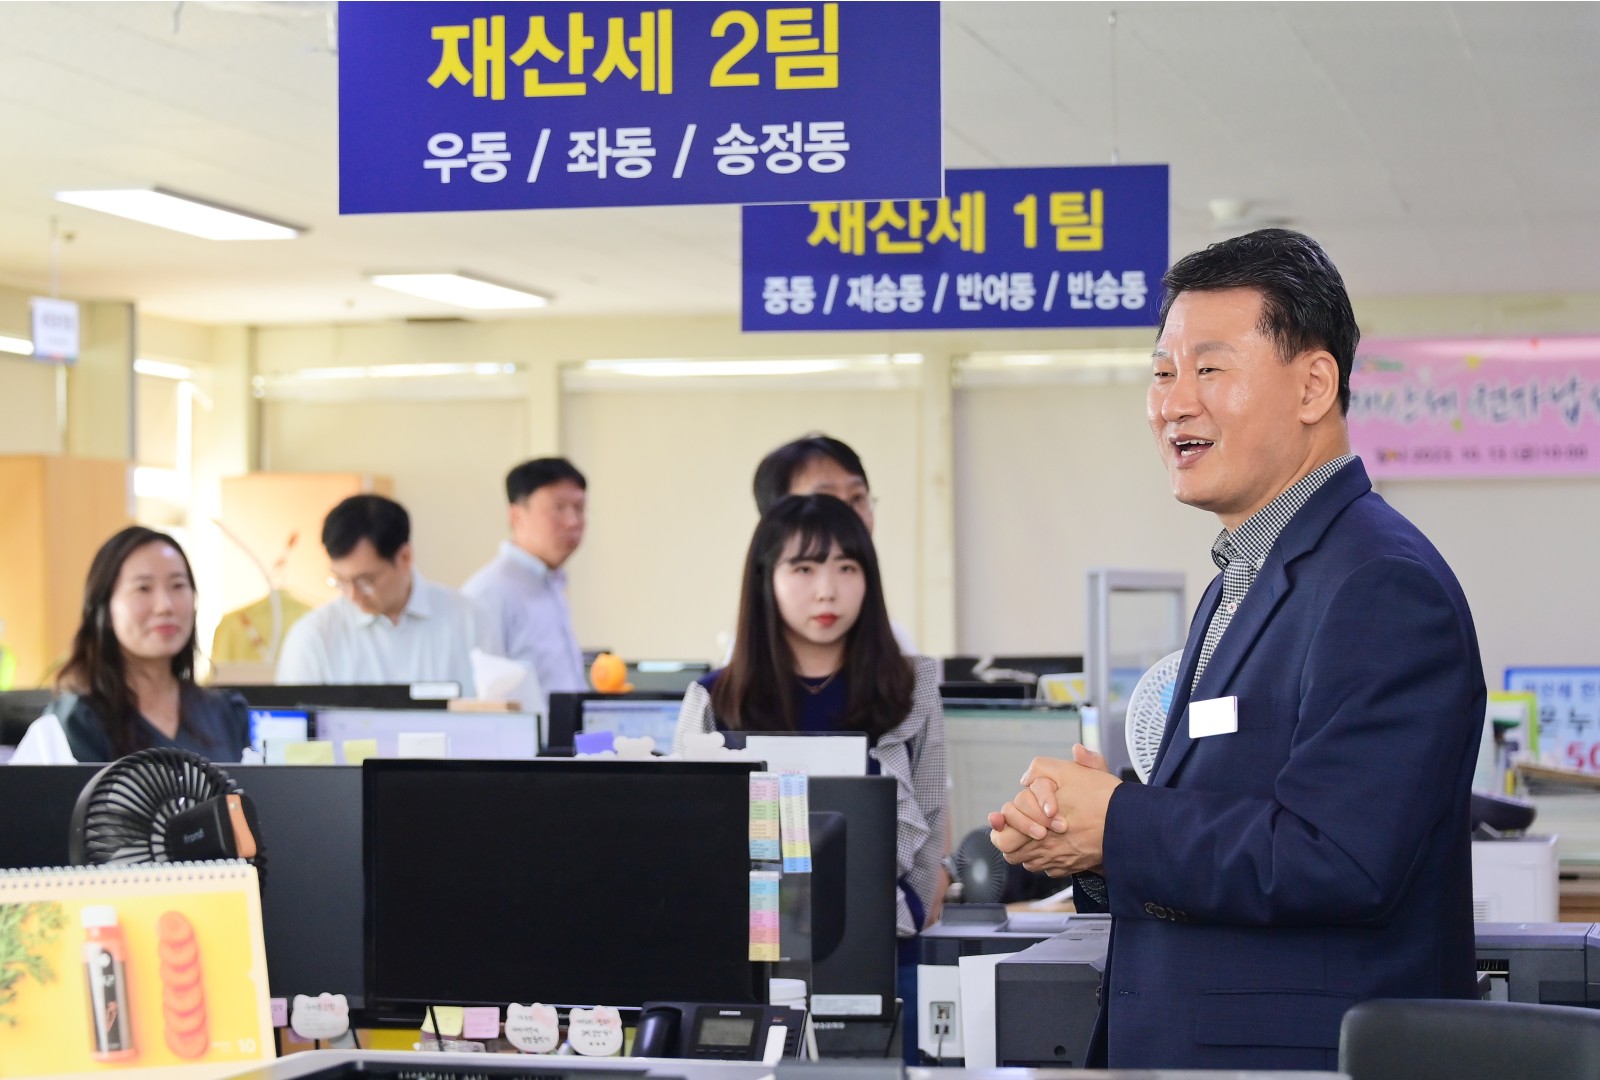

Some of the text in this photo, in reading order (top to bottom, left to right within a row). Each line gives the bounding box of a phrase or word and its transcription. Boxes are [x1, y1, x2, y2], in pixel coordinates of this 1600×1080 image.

[427, 3, 840, 101] 재산세 2팀
[423, 120, 850, 184] 우동 / 좌동 / 송정동
[807, 189, 1104, 256] 재산세 1팀
[762, 270, 1149, 316] 중동 / 재송동 / 반여동 / 반송동
